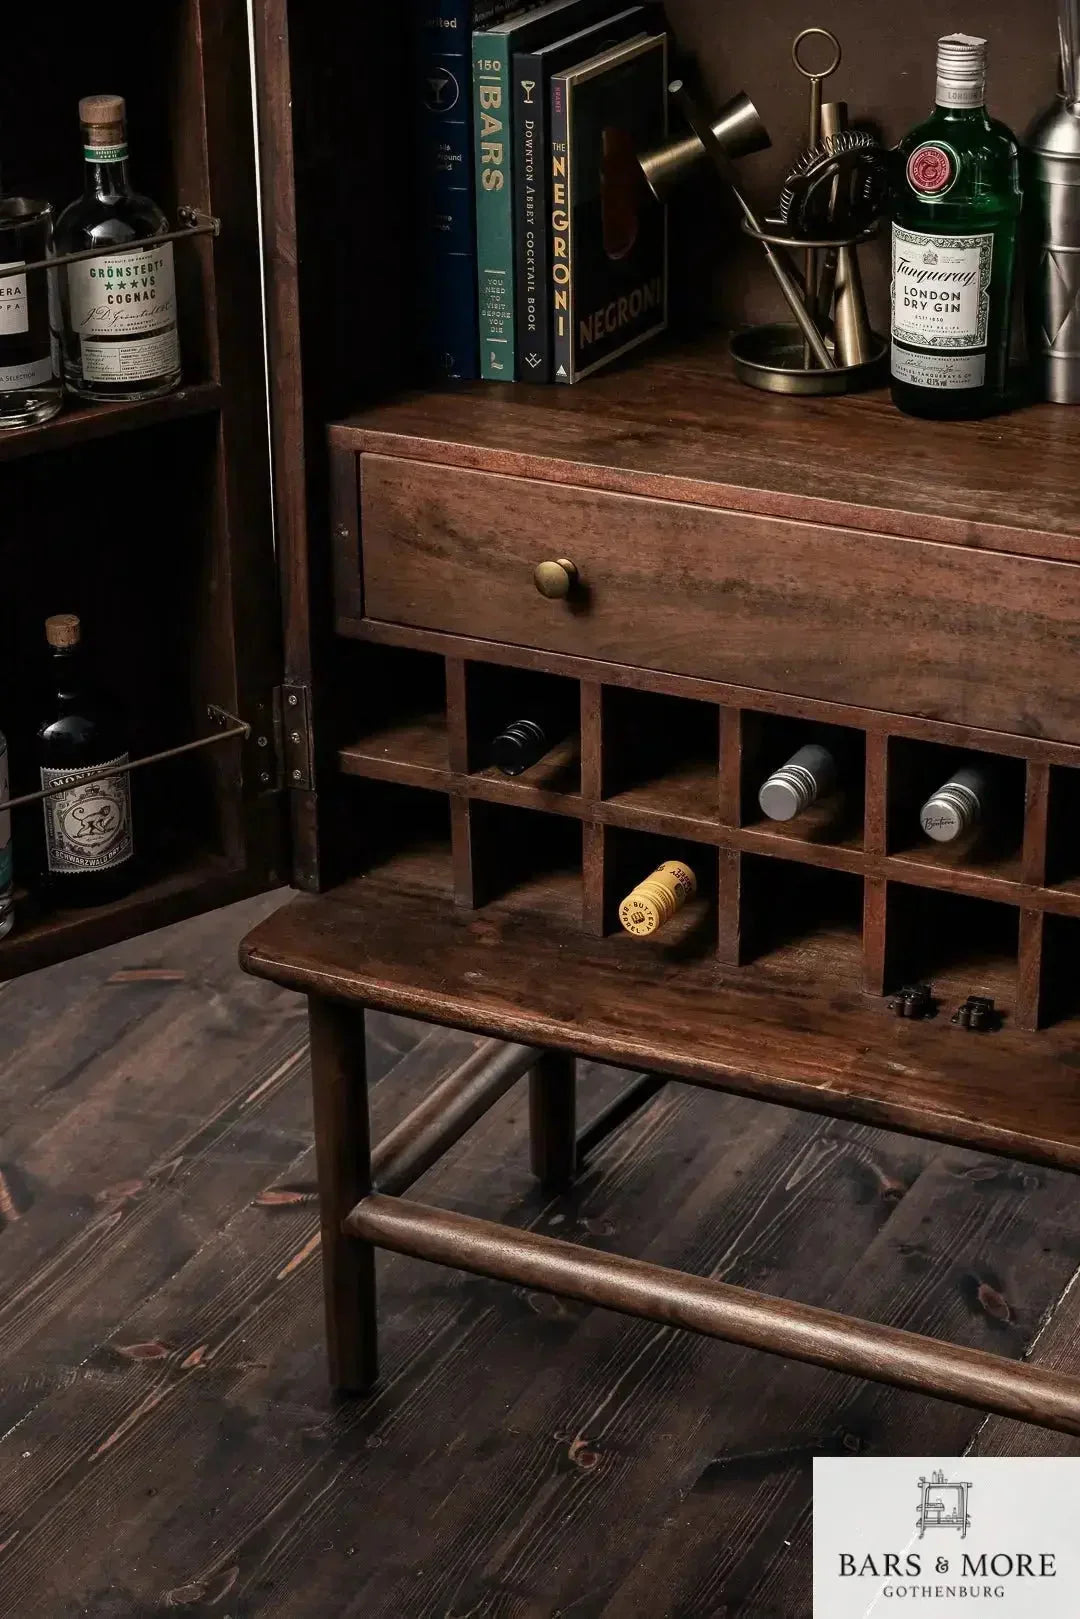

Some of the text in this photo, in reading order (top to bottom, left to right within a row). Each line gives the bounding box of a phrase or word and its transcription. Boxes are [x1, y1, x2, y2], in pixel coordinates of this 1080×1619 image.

[476, 59, 502, 72] 150
[478, 84, 504, 191] BARS
[551, 141, 567, 152] THE
[524, 119, 537, 332] DOWNTON ABBEY COCKTAIL BOOK
[551, 156, 571, 337] NEGRONI
[141, 276, 156, 287] VS
[107, 289, 157, 305] COGNAC
[490, 294, 501, 302] TO
[904, 286, 961, 301] LONDON
[904, 297, 961, 313] DRY GIN
[489, 318, 504, 326] YOU
[621, 901, 654, 934] BUTTERY BARREL
